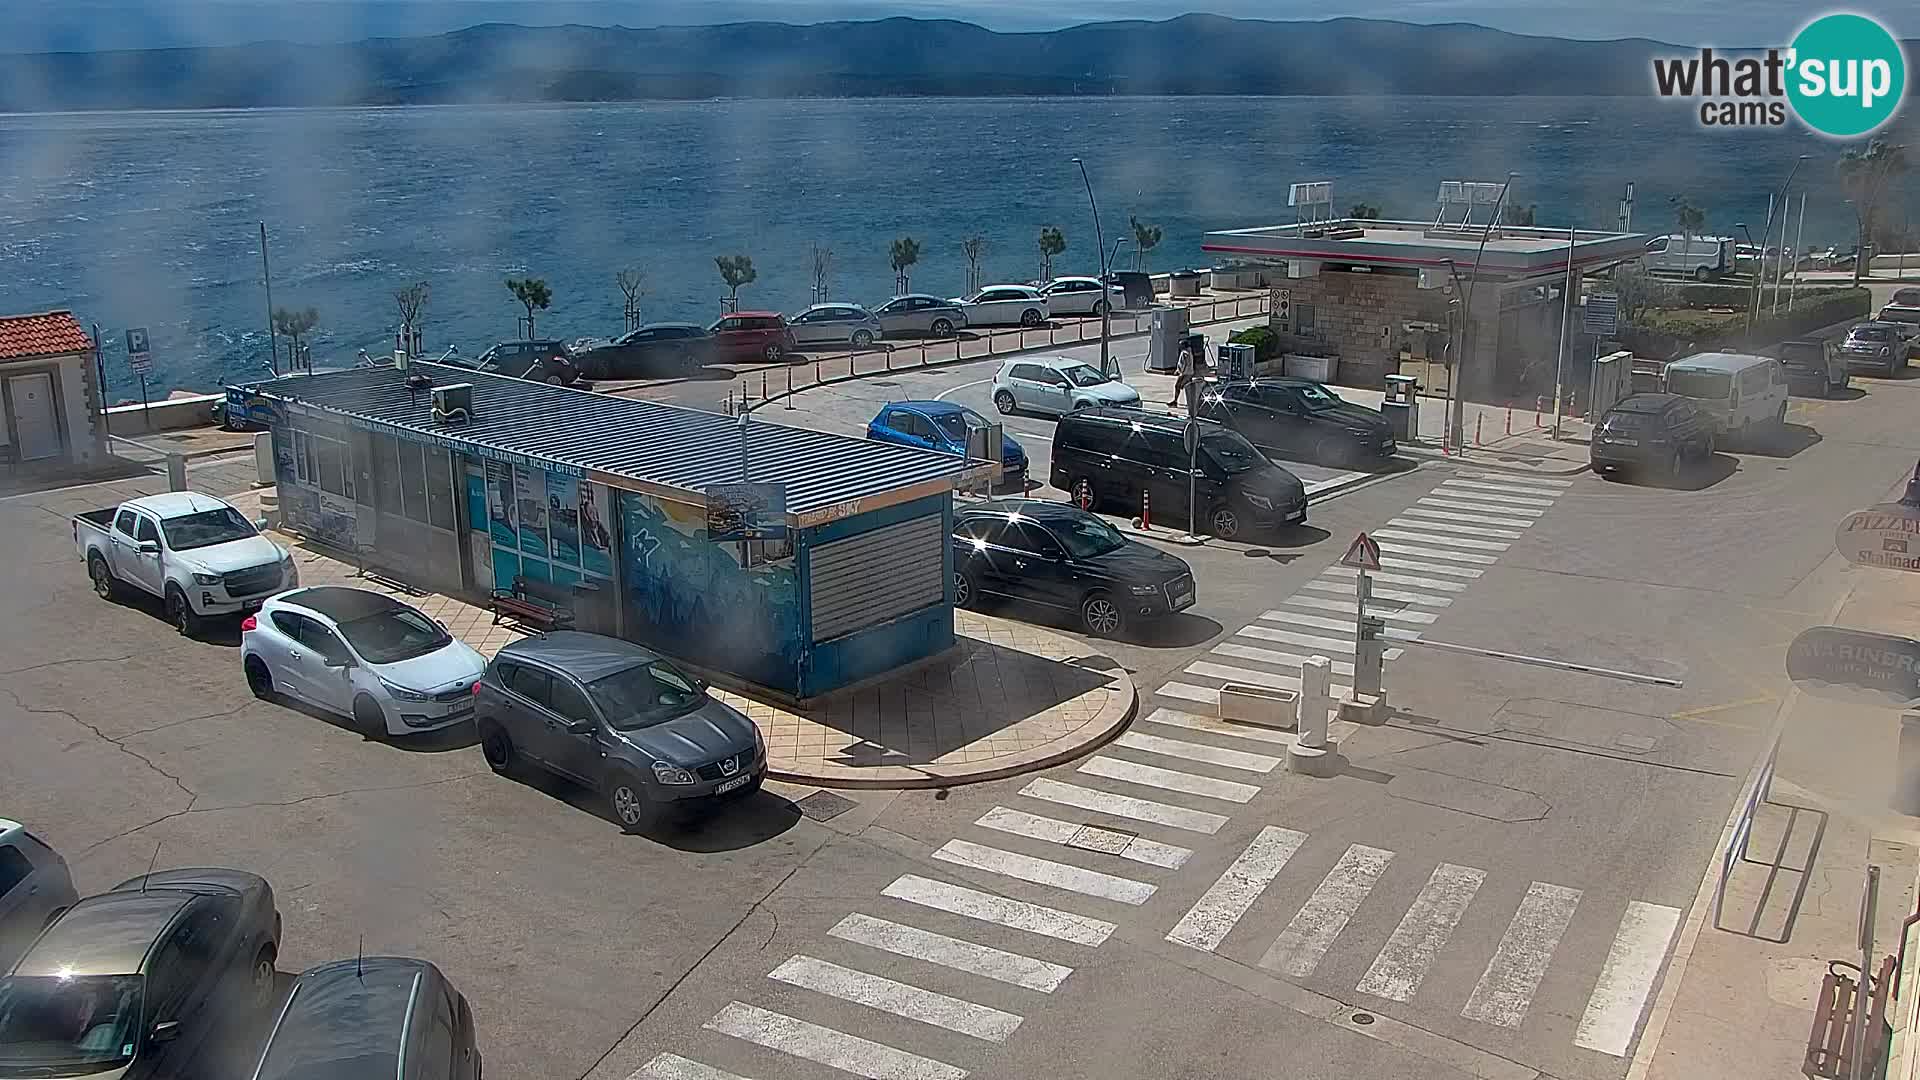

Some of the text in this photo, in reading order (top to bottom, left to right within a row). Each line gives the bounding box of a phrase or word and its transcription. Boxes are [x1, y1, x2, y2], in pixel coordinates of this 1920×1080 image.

[132, 332, 143, 350] P
[437, 438, 468, 451] POSTAJA
[478, 446, 493, 458] BUS
[495, 449, 526, 464] STATION
[529, 457, 554, 470] TICKET
[555, 463, 582, 477] OFFICE
